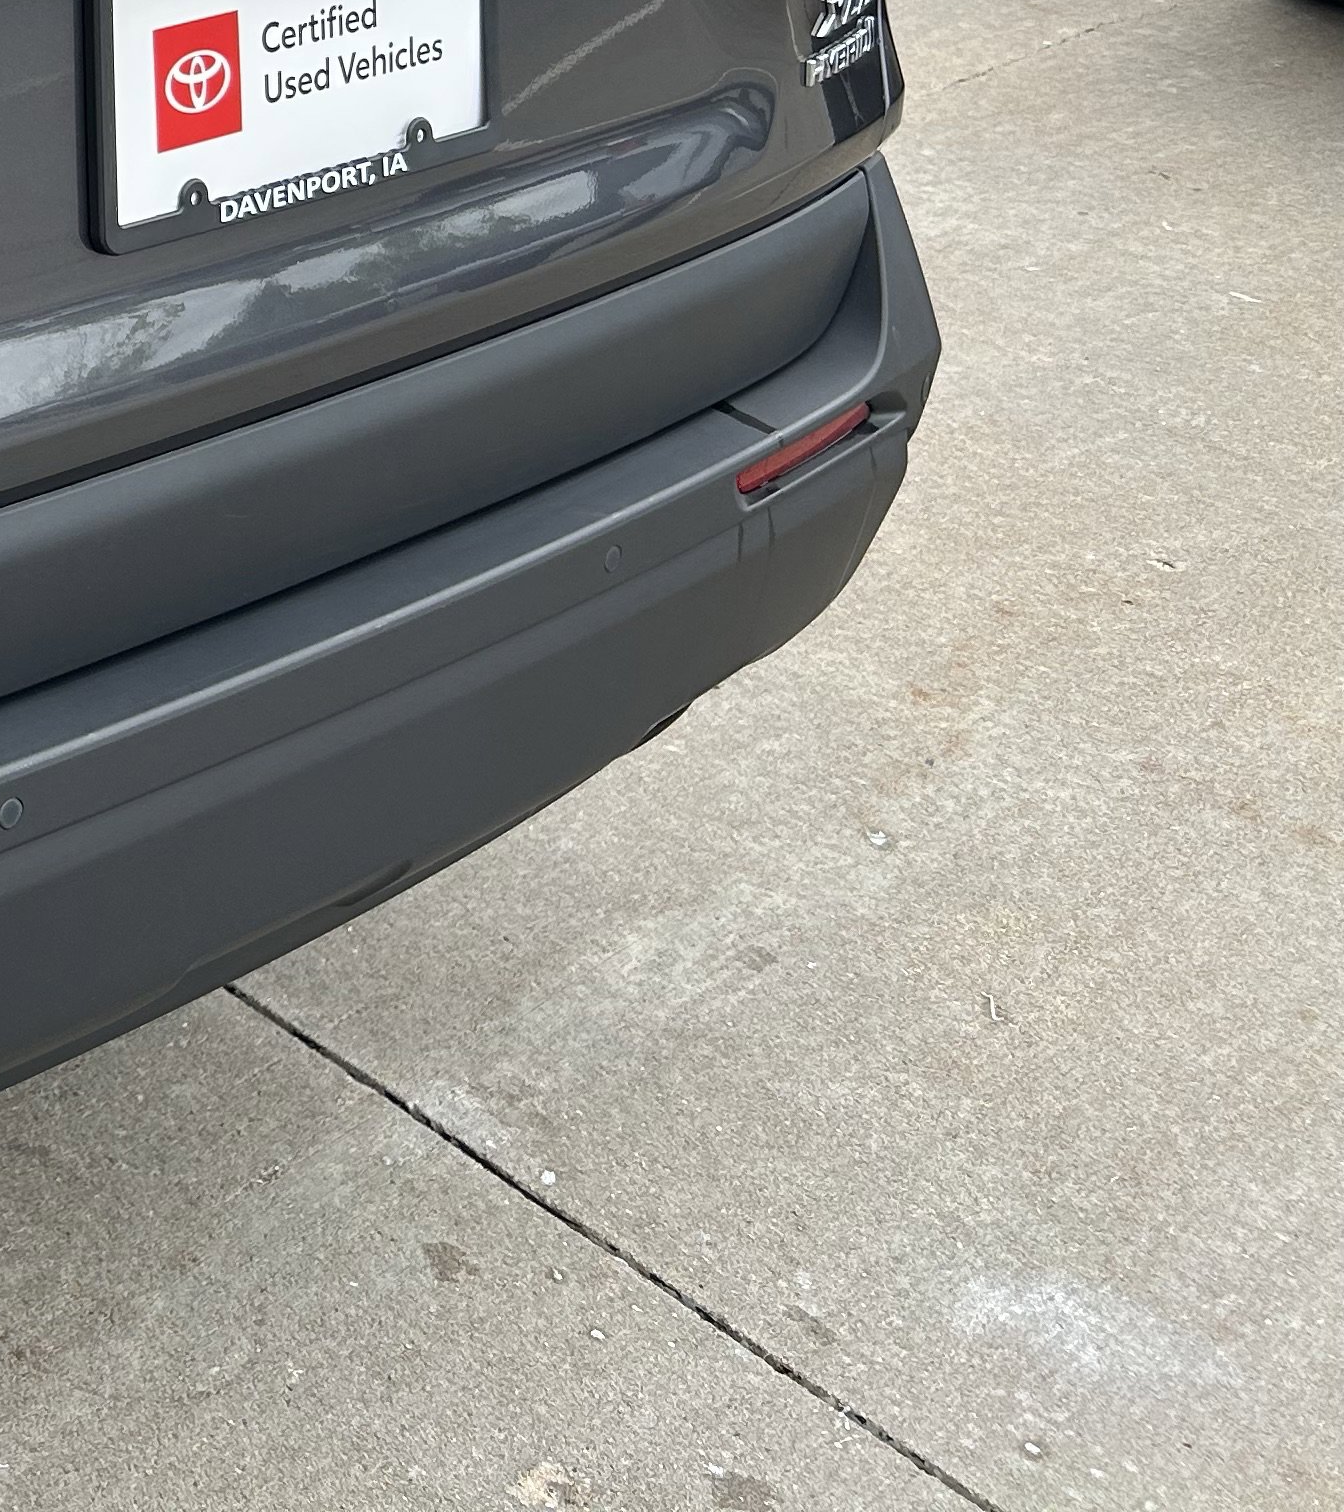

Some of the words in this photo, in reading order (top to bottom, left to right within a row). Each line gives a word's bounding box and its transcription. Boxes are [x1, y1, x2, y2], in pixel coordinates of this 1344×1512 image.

[264, 57, 330, 104] Used
[338, 36, 443, 83] Vehicles
[219, 162, 377, 223] DAVENPORT,
[382, 152, 408, 177] IA
